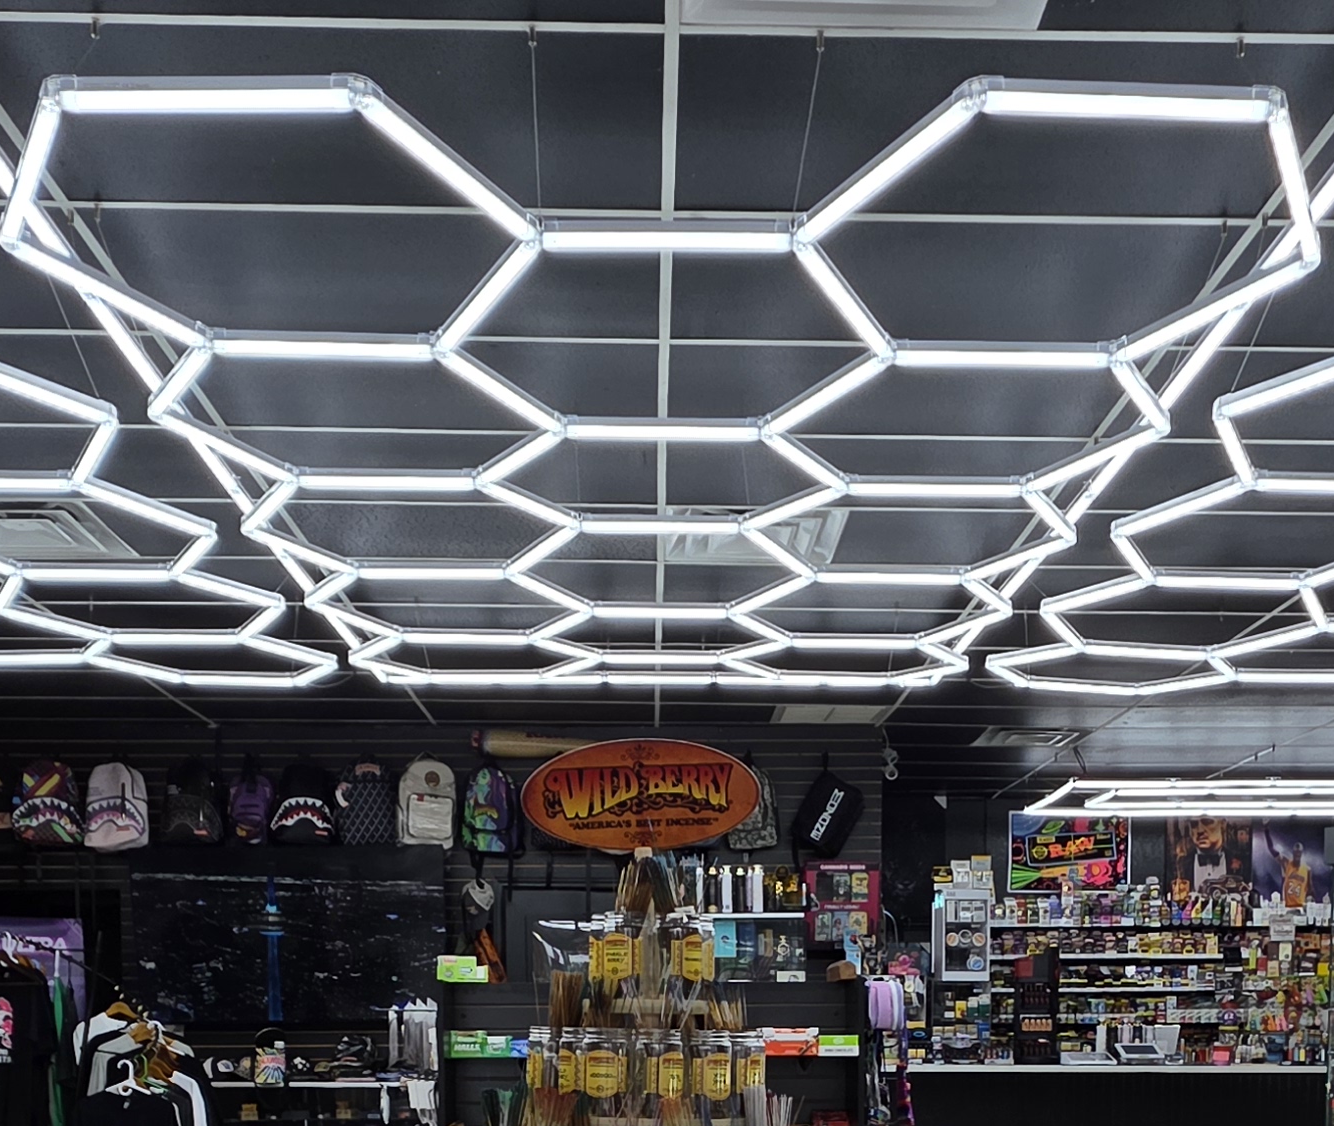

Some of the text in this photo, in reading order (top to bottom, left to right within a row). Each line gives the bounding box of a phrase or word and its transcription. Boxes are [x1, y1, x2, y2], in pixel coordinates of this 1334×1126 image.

[545, 763, 734, 820] WILD BERRY
[635, 817, 663, 828] BEST
[1048, 835, 1096, 858] RAW
[1288, 882, 1302, 897] 24
